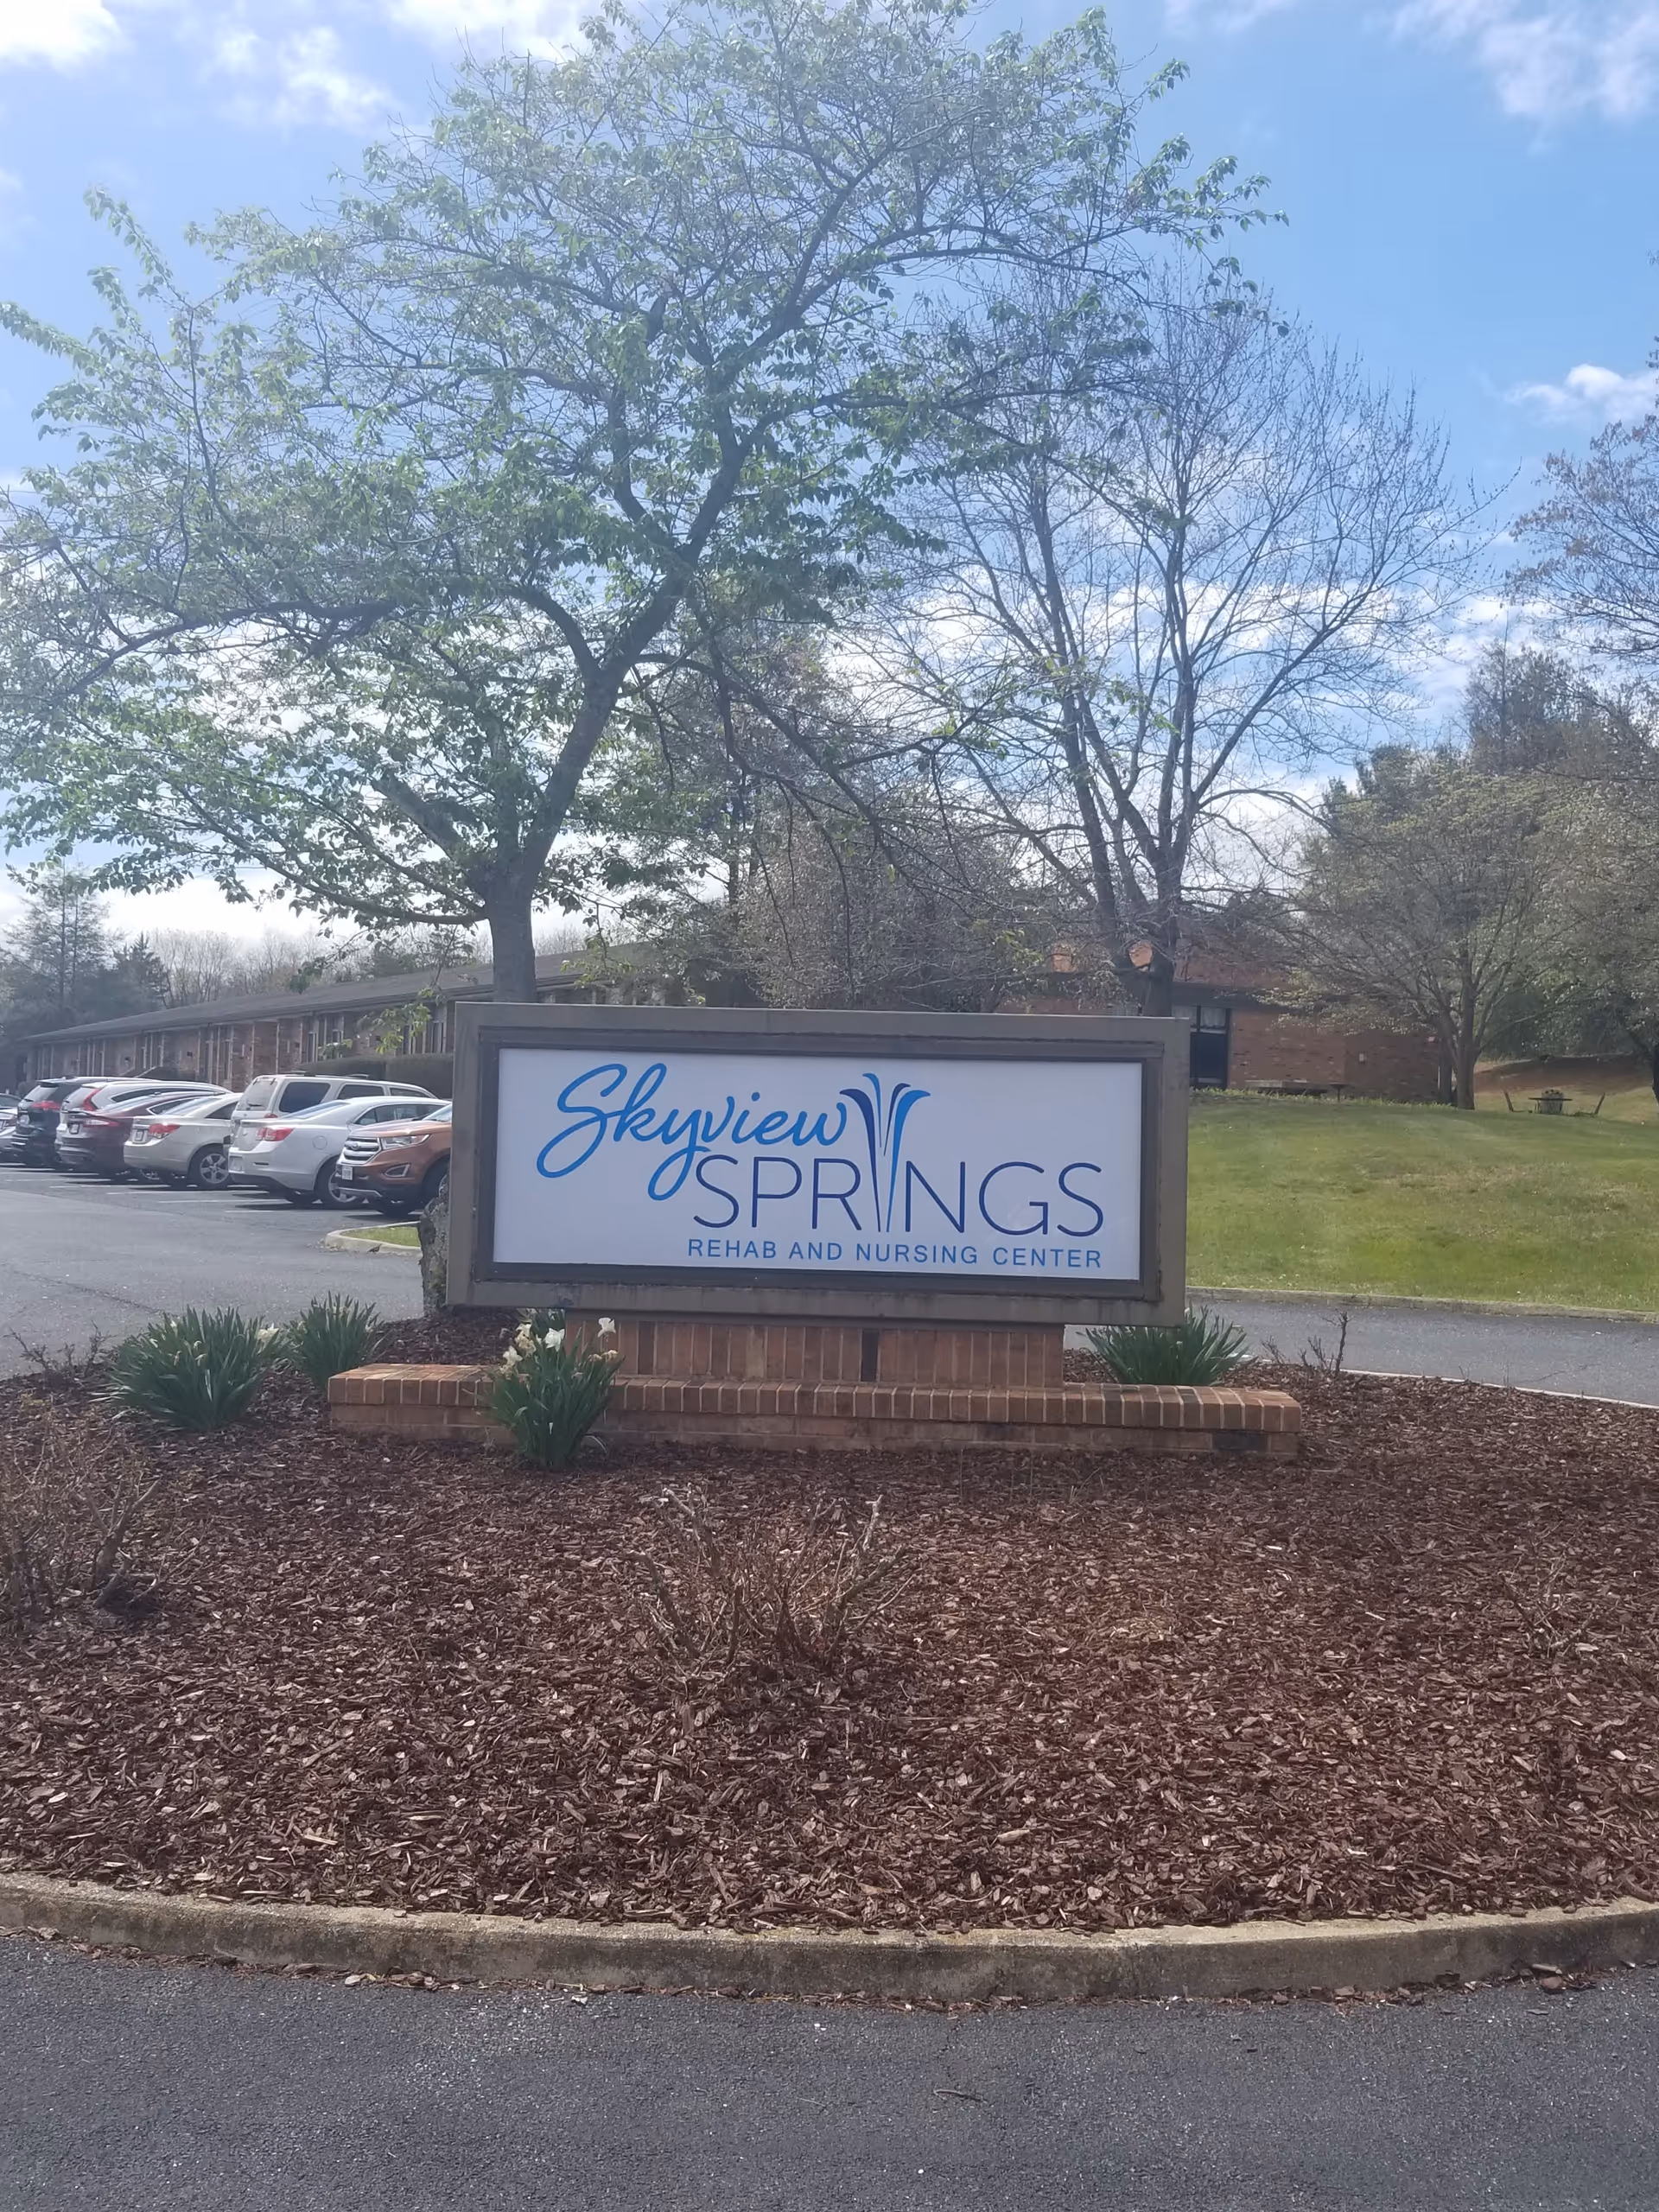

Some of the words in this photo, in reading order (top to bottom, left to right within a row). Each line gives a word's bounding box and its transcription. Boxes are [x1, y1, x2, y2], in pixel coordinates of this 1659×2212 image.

[536, 1062, 847, 1202] Skyview
[688, 1237, 777, 1260] REHAB
[788, 1240, 843, 1262] AND
[855, 1243, 979, 1266] NURSING
[992, 1245, 1103, 1269] CENTER
